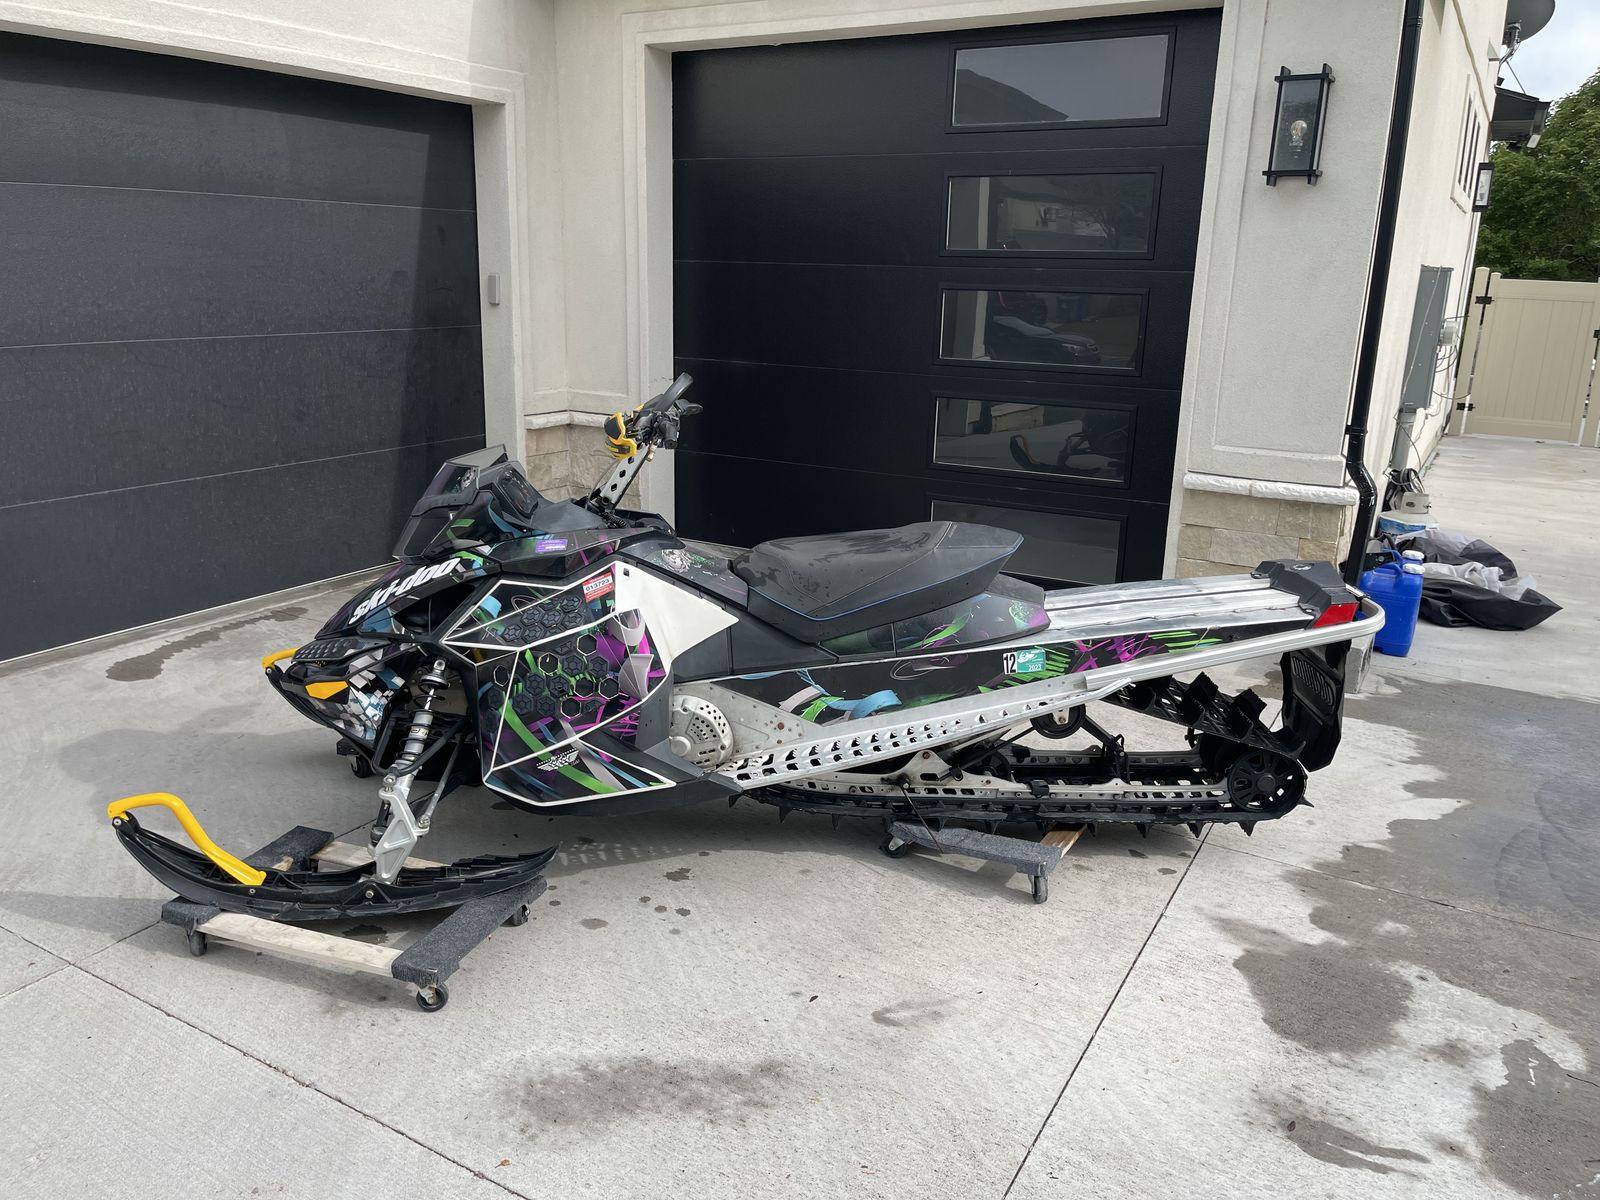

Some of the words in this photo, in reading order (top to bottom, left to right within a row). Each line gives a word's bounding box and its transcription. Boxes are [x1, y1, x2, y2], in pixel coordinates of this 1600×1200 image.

[585, 578, 610, 592] 013723
[1003, 653, 1017, 674] 12
[1028, 663, 1042, 672] 2023
